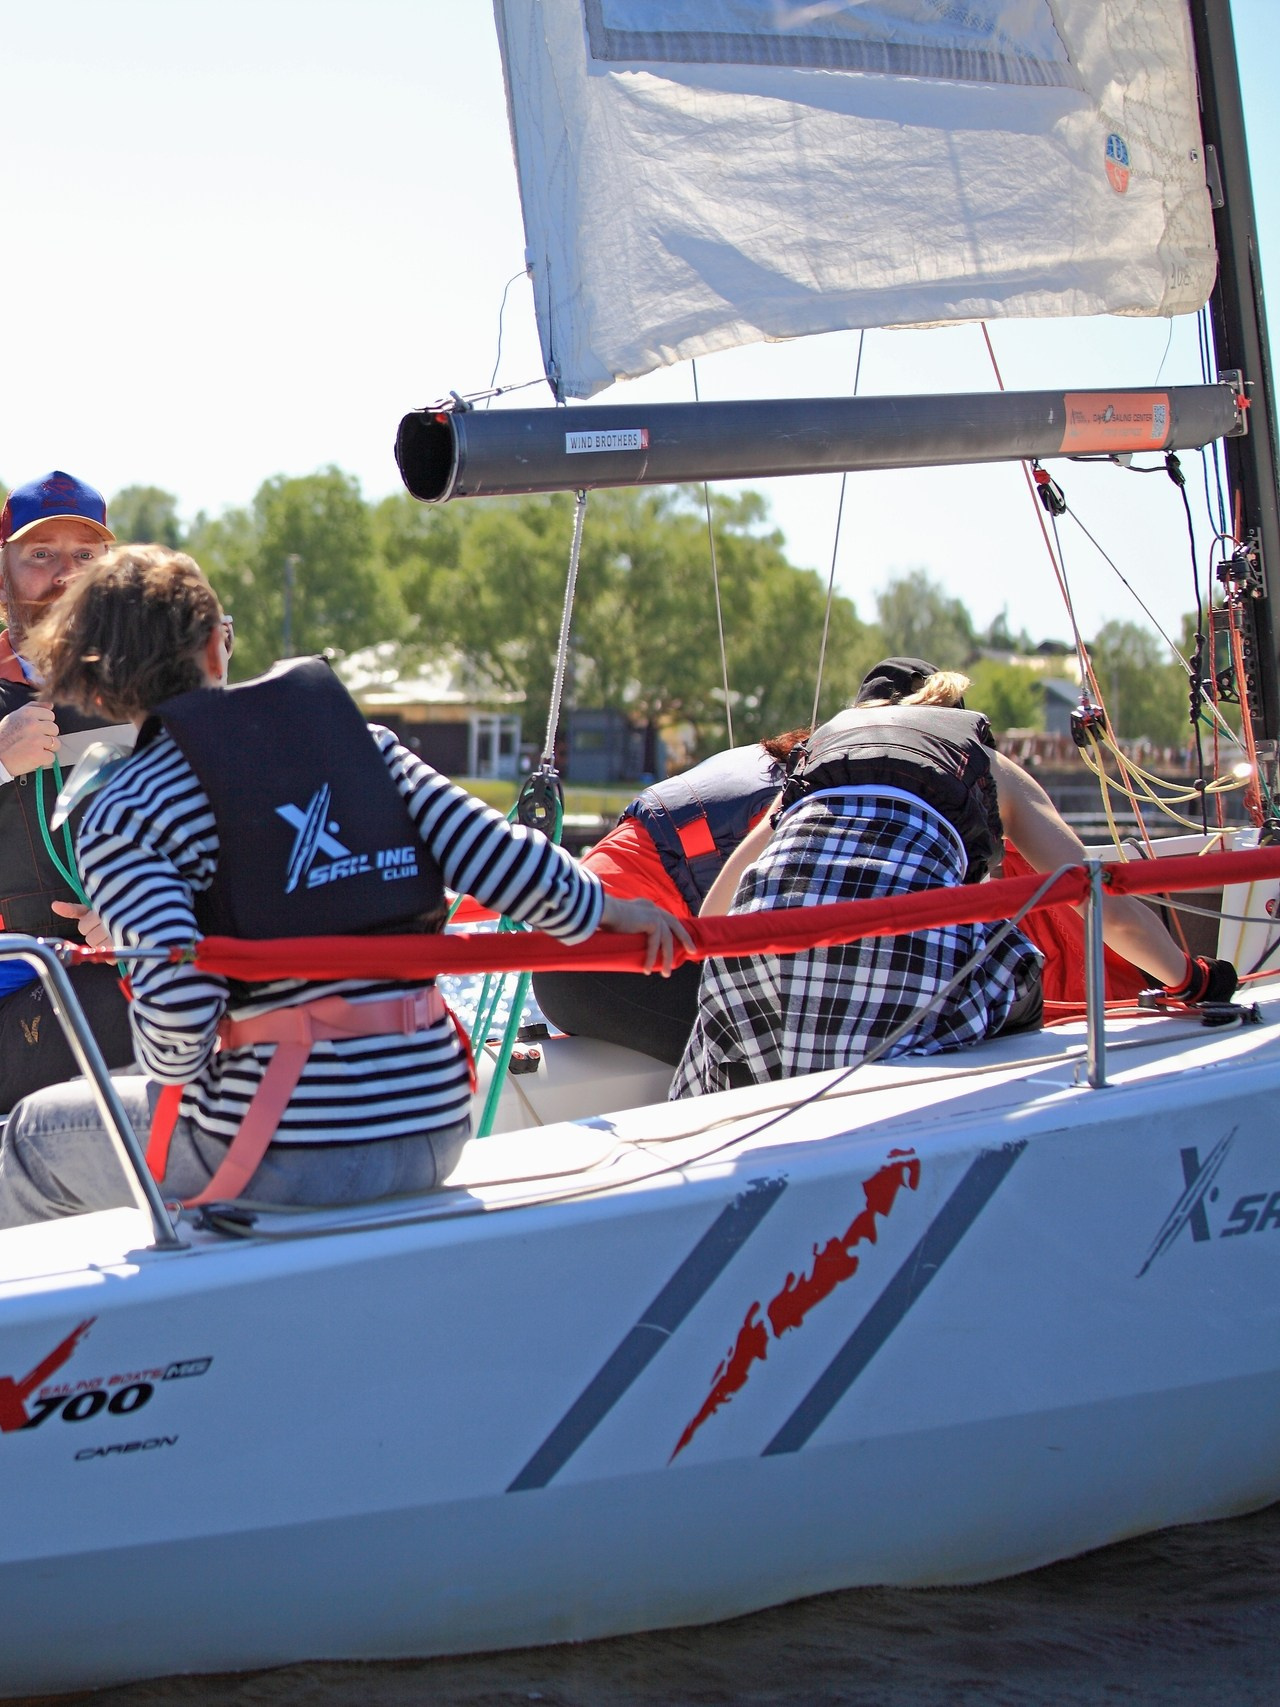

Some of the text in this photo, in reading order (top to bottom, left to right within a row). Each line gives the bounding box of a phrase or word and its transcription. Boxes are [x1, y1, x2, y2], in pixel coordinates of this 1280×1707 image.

[570, 434, 638, 449] WIND BROTHERS
[382, 864, 419, 882] CLUB
[74, 1433, 179, 1461] CARBON
